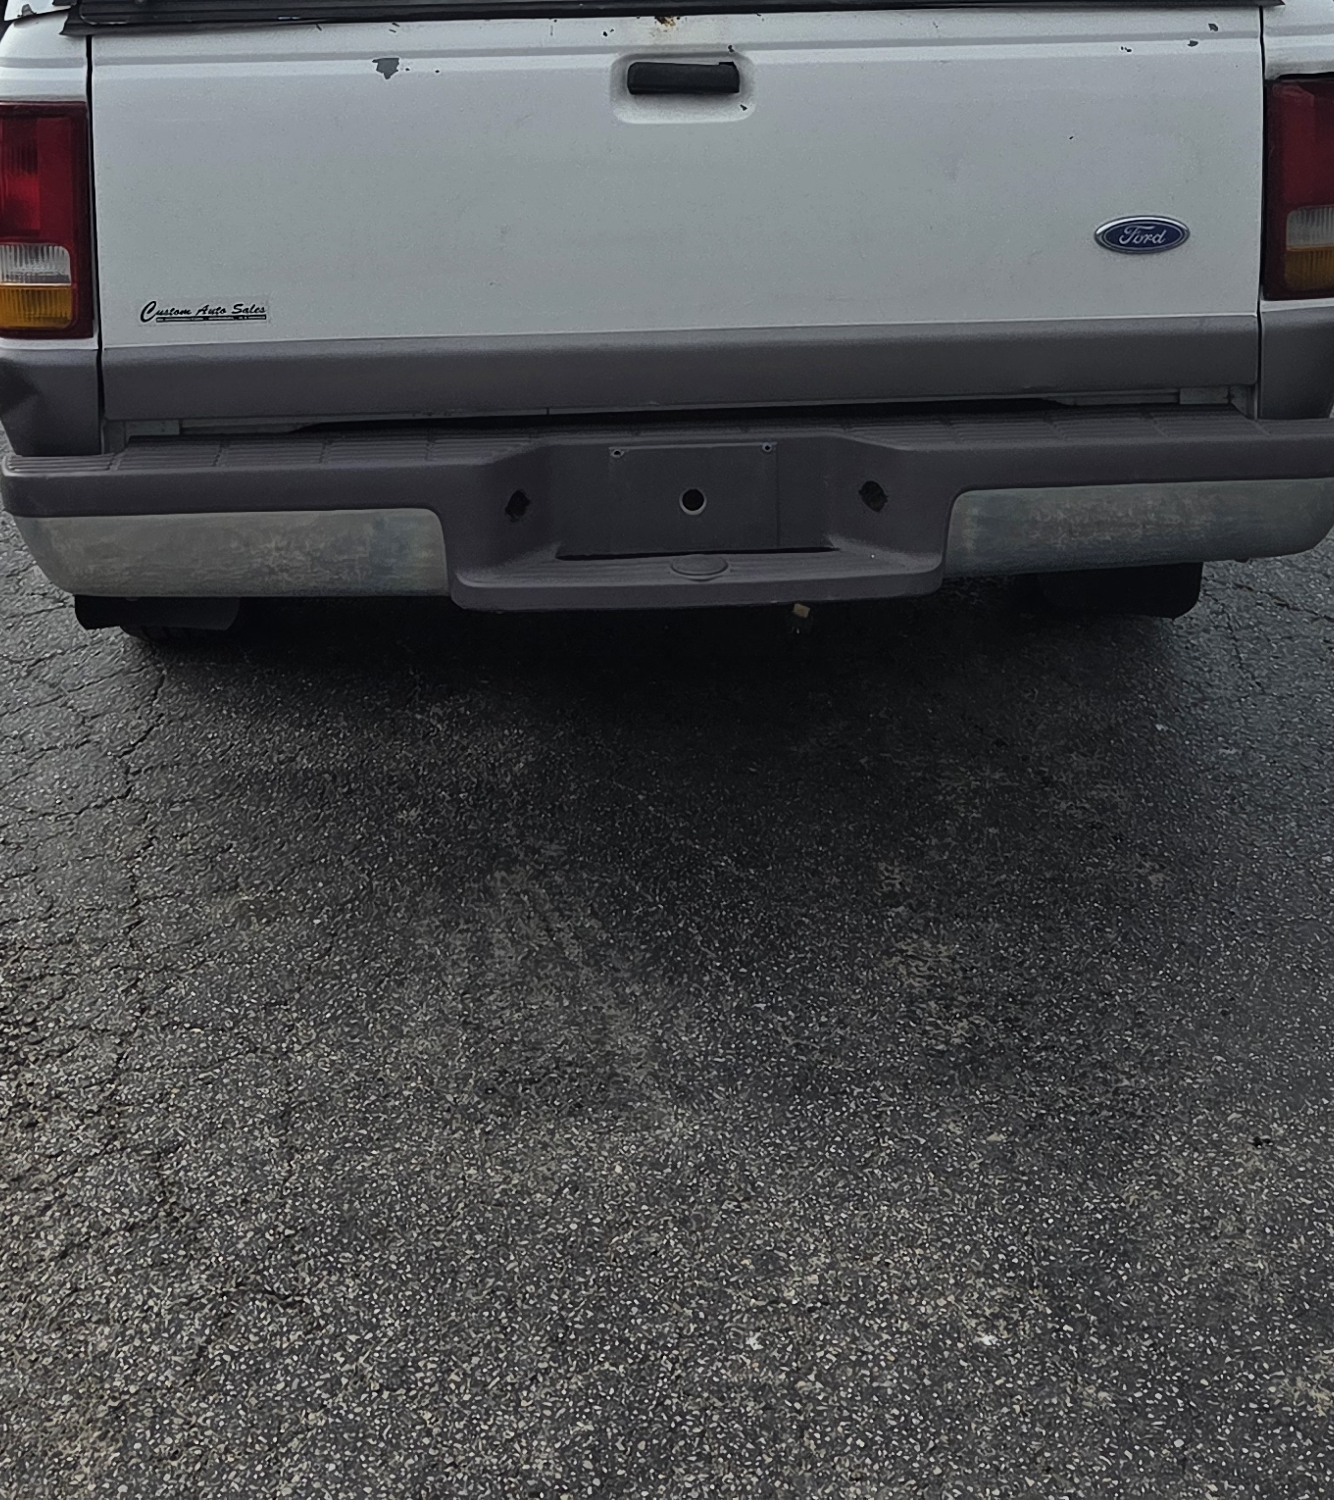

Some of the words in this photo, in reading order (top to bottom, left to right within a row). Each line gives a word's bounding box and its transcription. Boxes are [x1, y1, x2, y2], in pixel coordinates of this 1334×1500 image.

[1118, 224, 1167, 245] Ford
[140, 300, 192, 323] Custom
[195, 304, 227, 316] Auto
[231, 303, 267, 315] Sales
